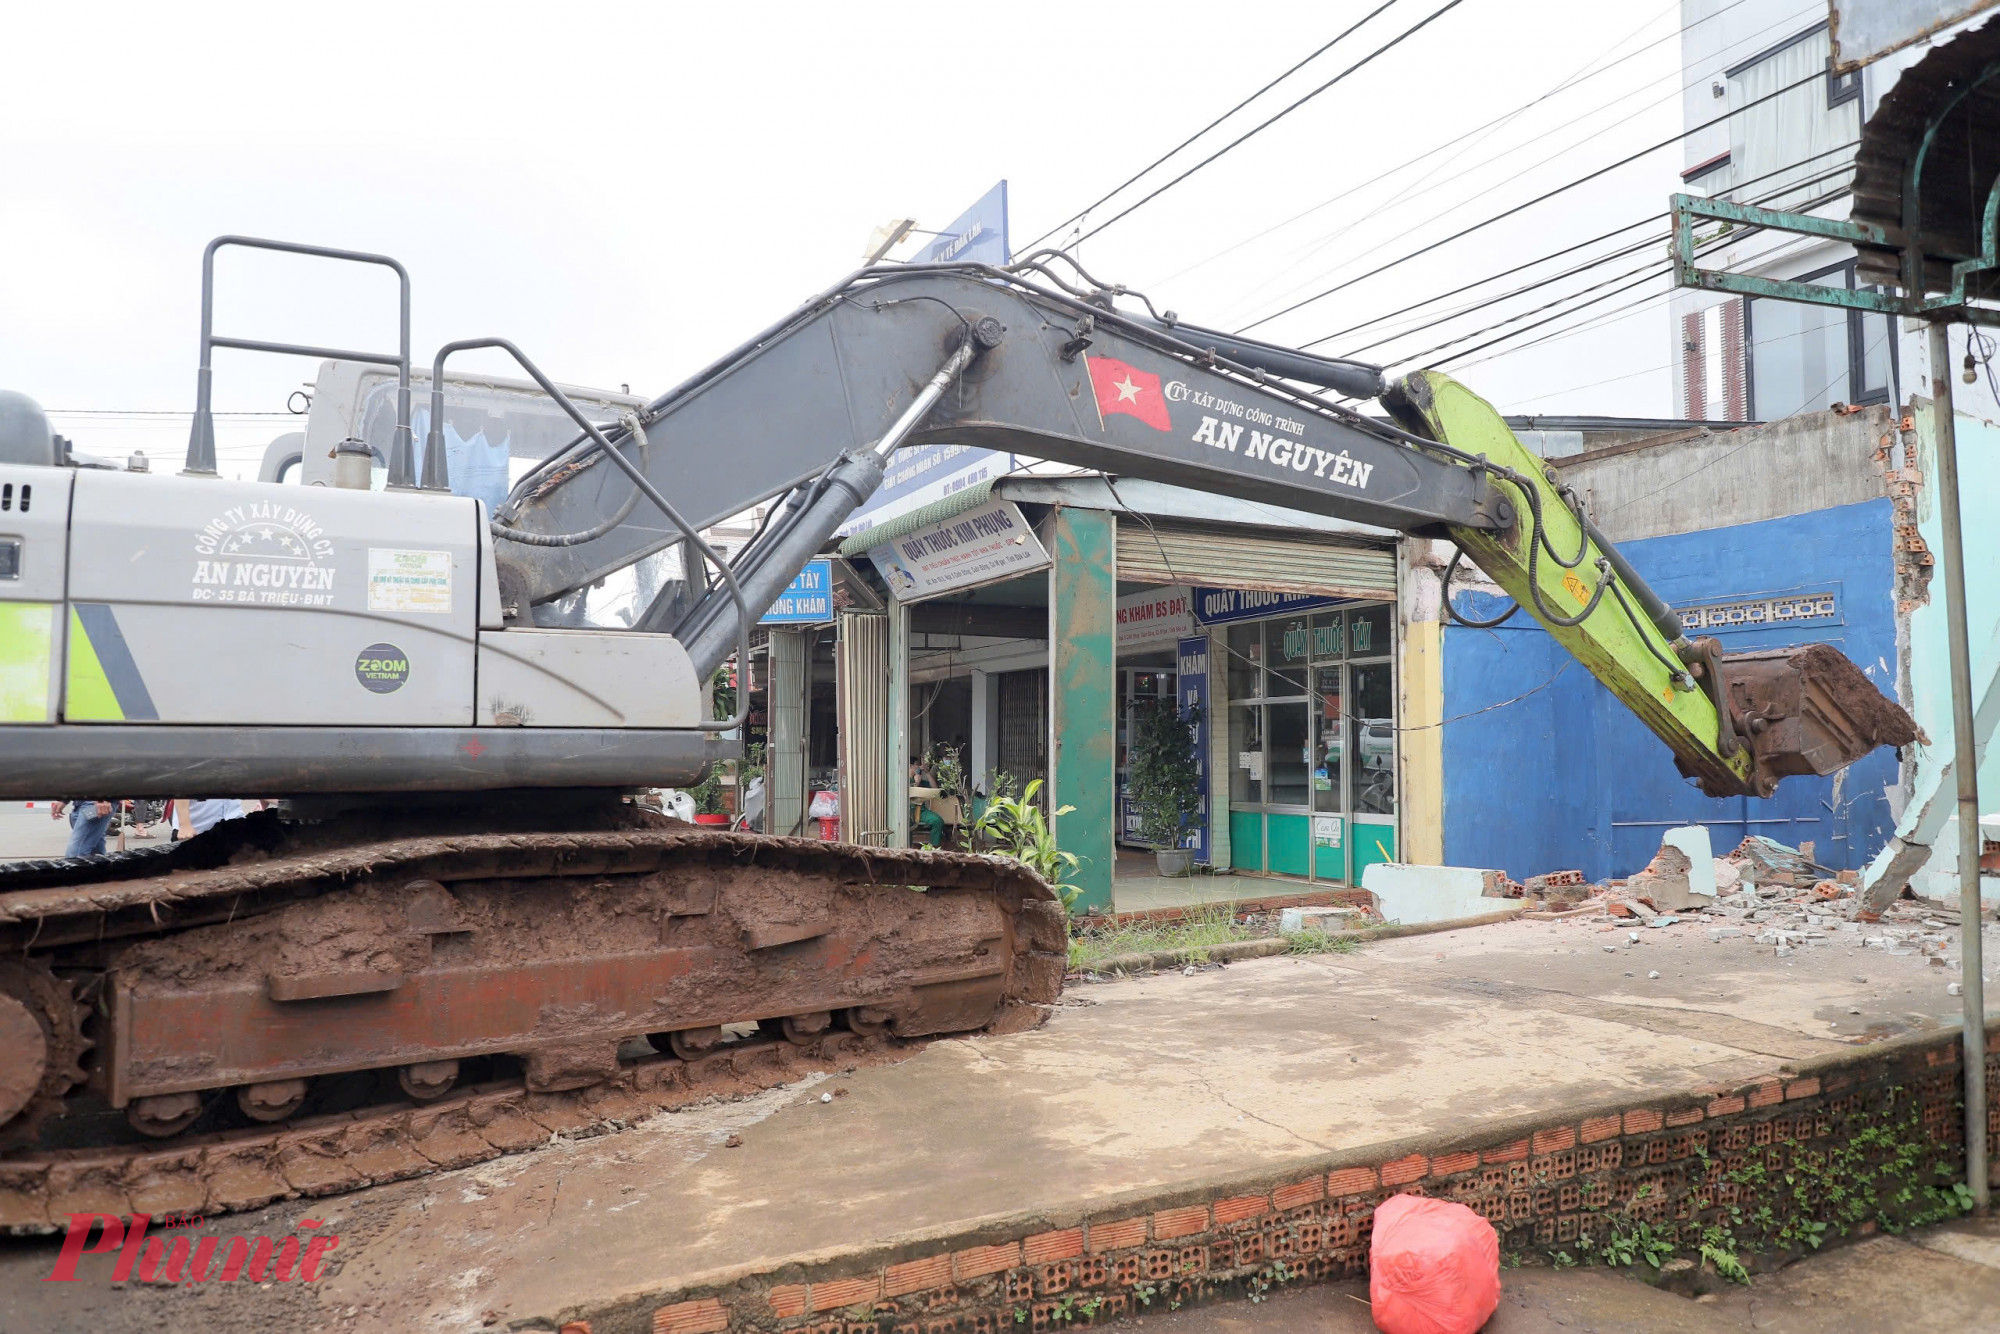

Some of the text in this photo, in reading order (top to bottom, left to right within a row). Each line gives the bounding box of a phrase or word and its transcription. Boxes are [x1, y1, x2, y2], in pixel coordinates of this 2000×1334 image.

[1191, 391, 1216, 408] XÂY
[1216, 401, 1244, 417] DỰNG
[1245, 407, 1273, 427] CÔNG
[1274, 416, 1306, 436] TRÌNH
[1191, 416, 1374, 489] AN NGUYÊN
[194, 517, 230, 555] CÔNG
[224, 506, 246, 525] TY
[250, 499, 282, 519] XÂY
[284, 507, 323, 541] DỰNG
[923, 522, 958, 553] THUỐC
[952, 520, 979, 544] KIM
[972, 508, 1014, 538] PHỤNG
[192, 560, 336, 590] AN NGUYÊN
[800, 569, 820, 589] TÂY
[218, 590, 234, 601] 35
[796, 594, 826, 614] KHÁM
[1129, 601, 1153, 622] KHÁM
[1156, 602, 1167, 618] BS
[1314, 616, 1344, 656] THUỐC
[1352, 616, 1372, 652] TÂY
[358, 659, 406, 672] ZOOM
[1180, 650, 1206, 676] KHÁM
